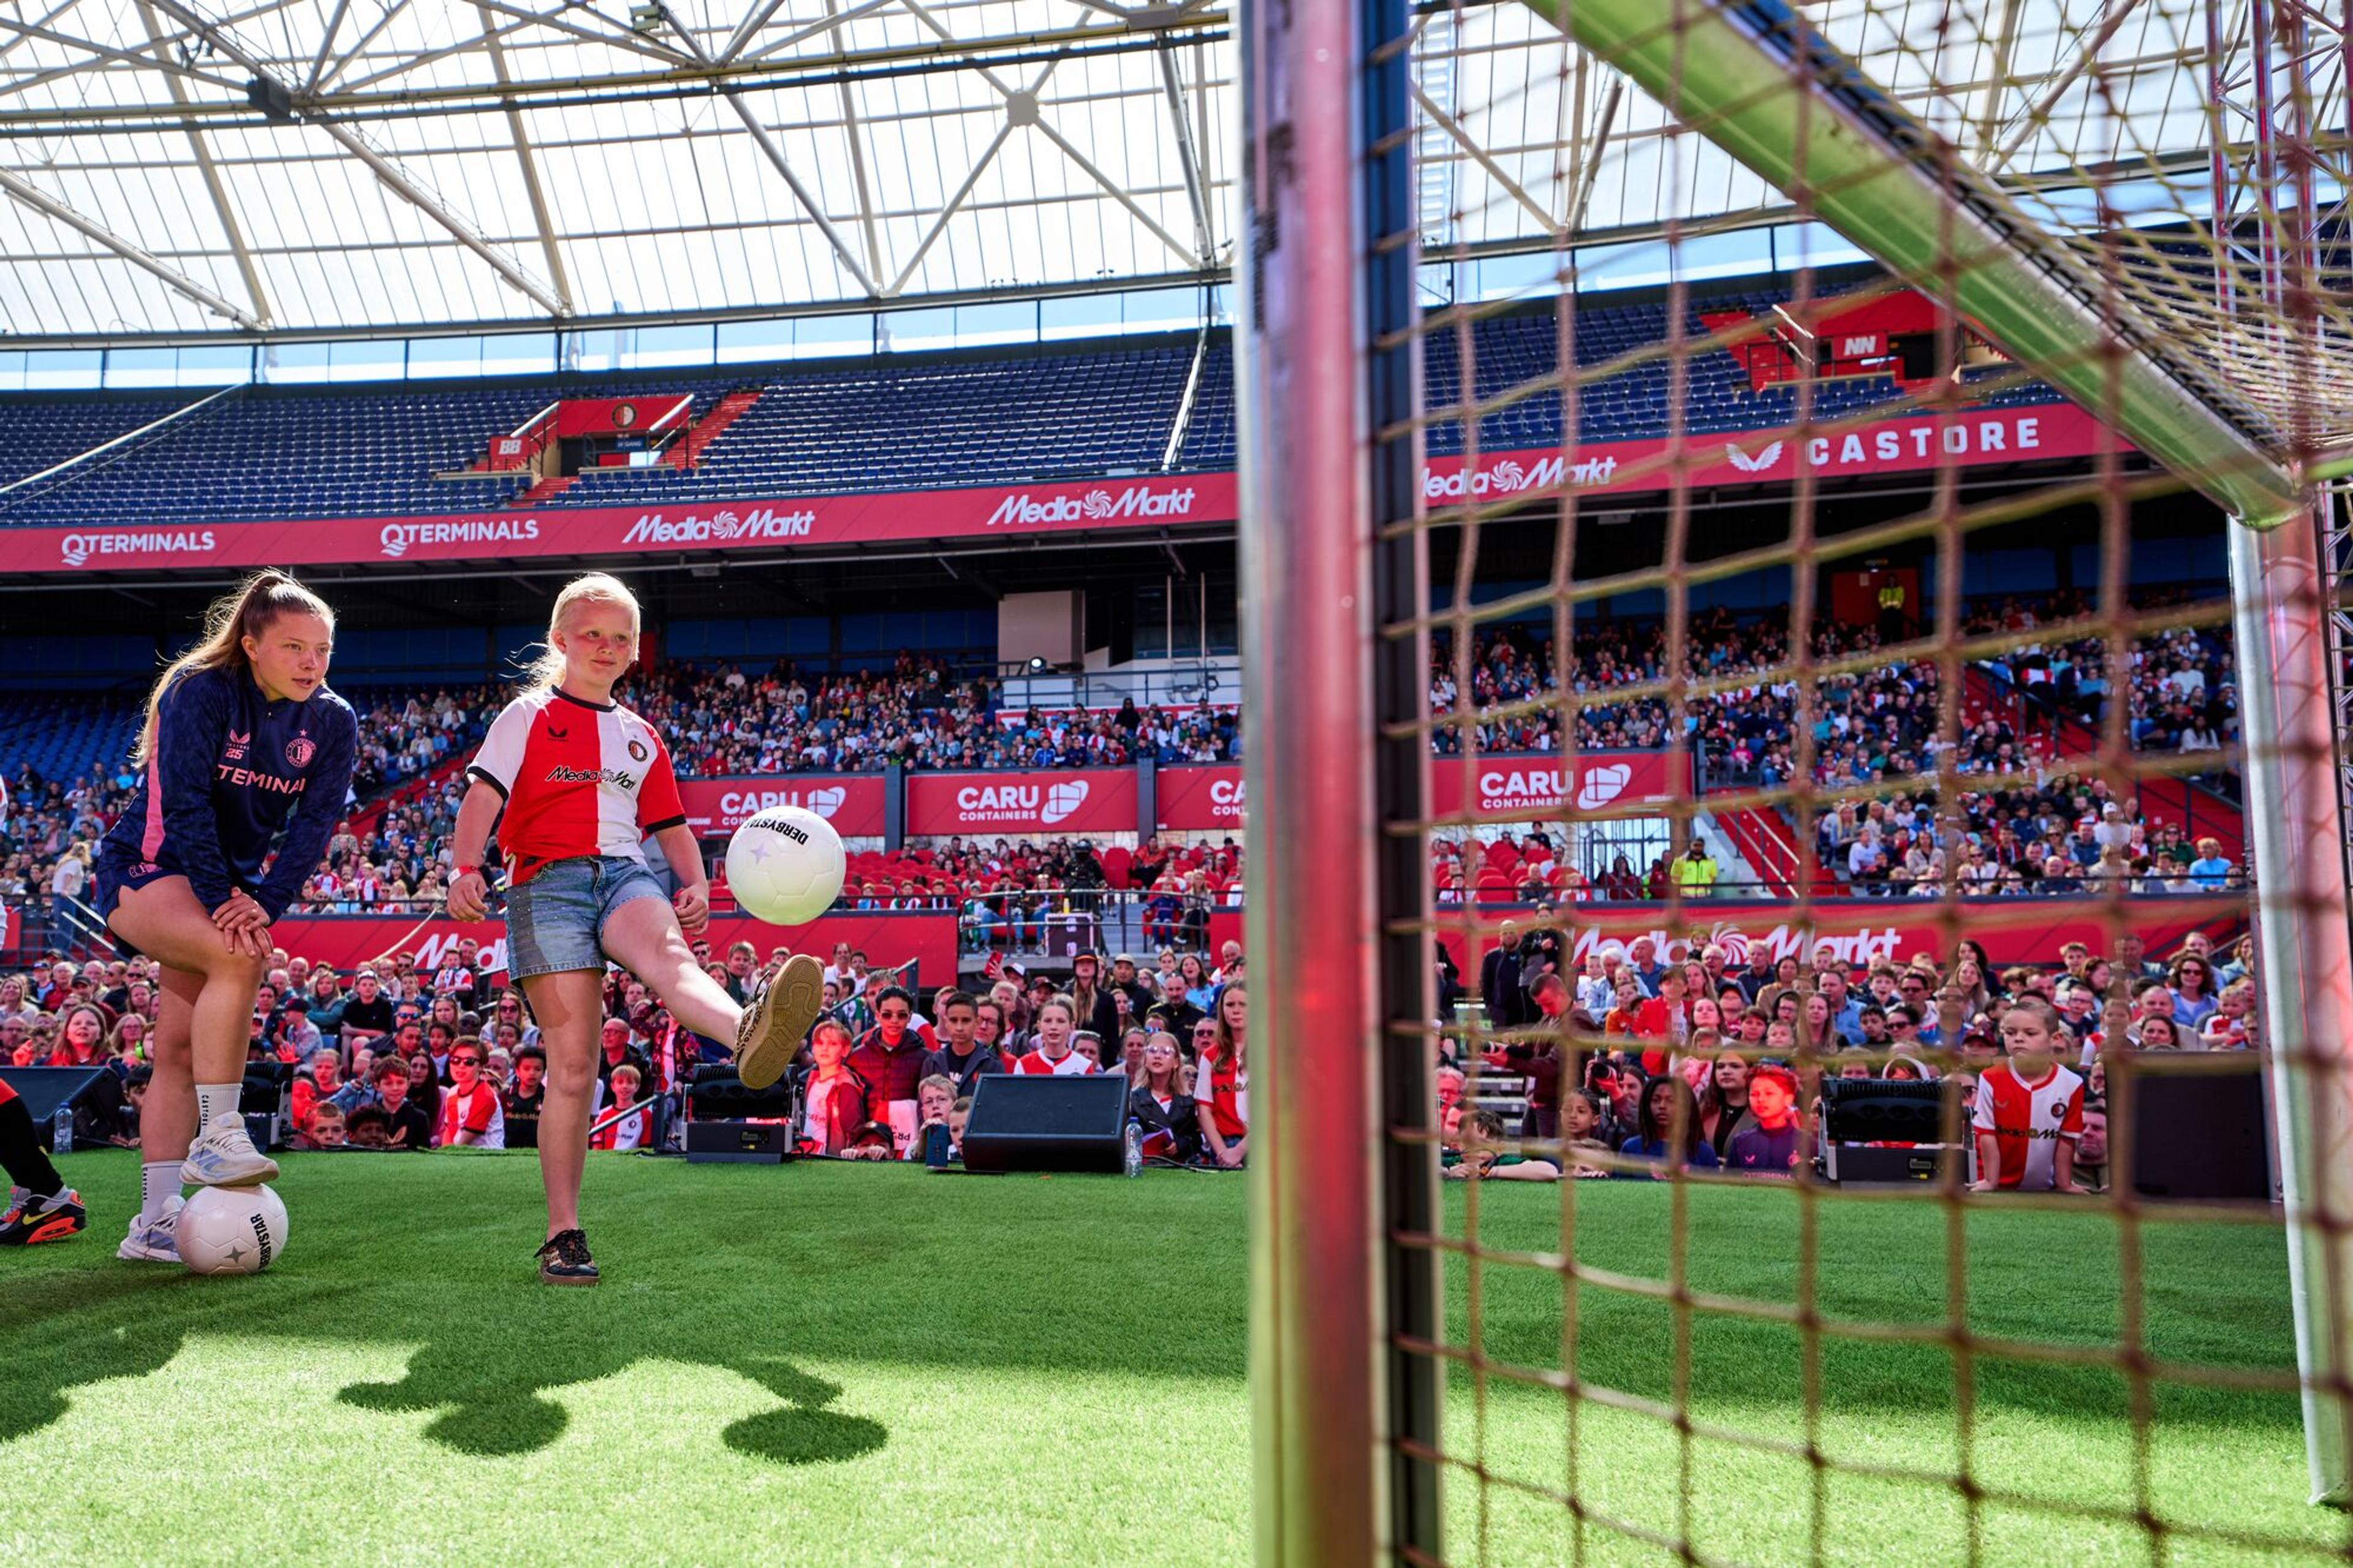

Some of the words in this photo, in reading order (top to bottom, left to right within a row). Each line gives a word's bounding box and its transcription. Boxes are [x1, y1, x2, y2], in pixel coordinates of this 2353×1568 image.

[1844, 336, 1876, 355] NN
[1808, 419, 2039, 465] CASTORE
[1518, 455, 1616, 490] Markt
[987, 495, 1081, 525] Media
[1105, 487, 1195, 517] Markt
[381, 519, 539, 557] QTERMINALS
[623, 515, 713, 544] Media
[733, 509, 815, 537] Markt
[62, 531, 215, 566] QTERMINALS
[225, 748, 244, 760] 25
[545, 765, 598, 782] Media
[1480, 771, 1574, 797] CARU
[958, 786, 1039, 810] CARU
[1482, 798, 1572, 809] CONTAINERS
[959, 810, 1037, 821] CONTAINERS
[1766, 923, 1900, 964] Markt
